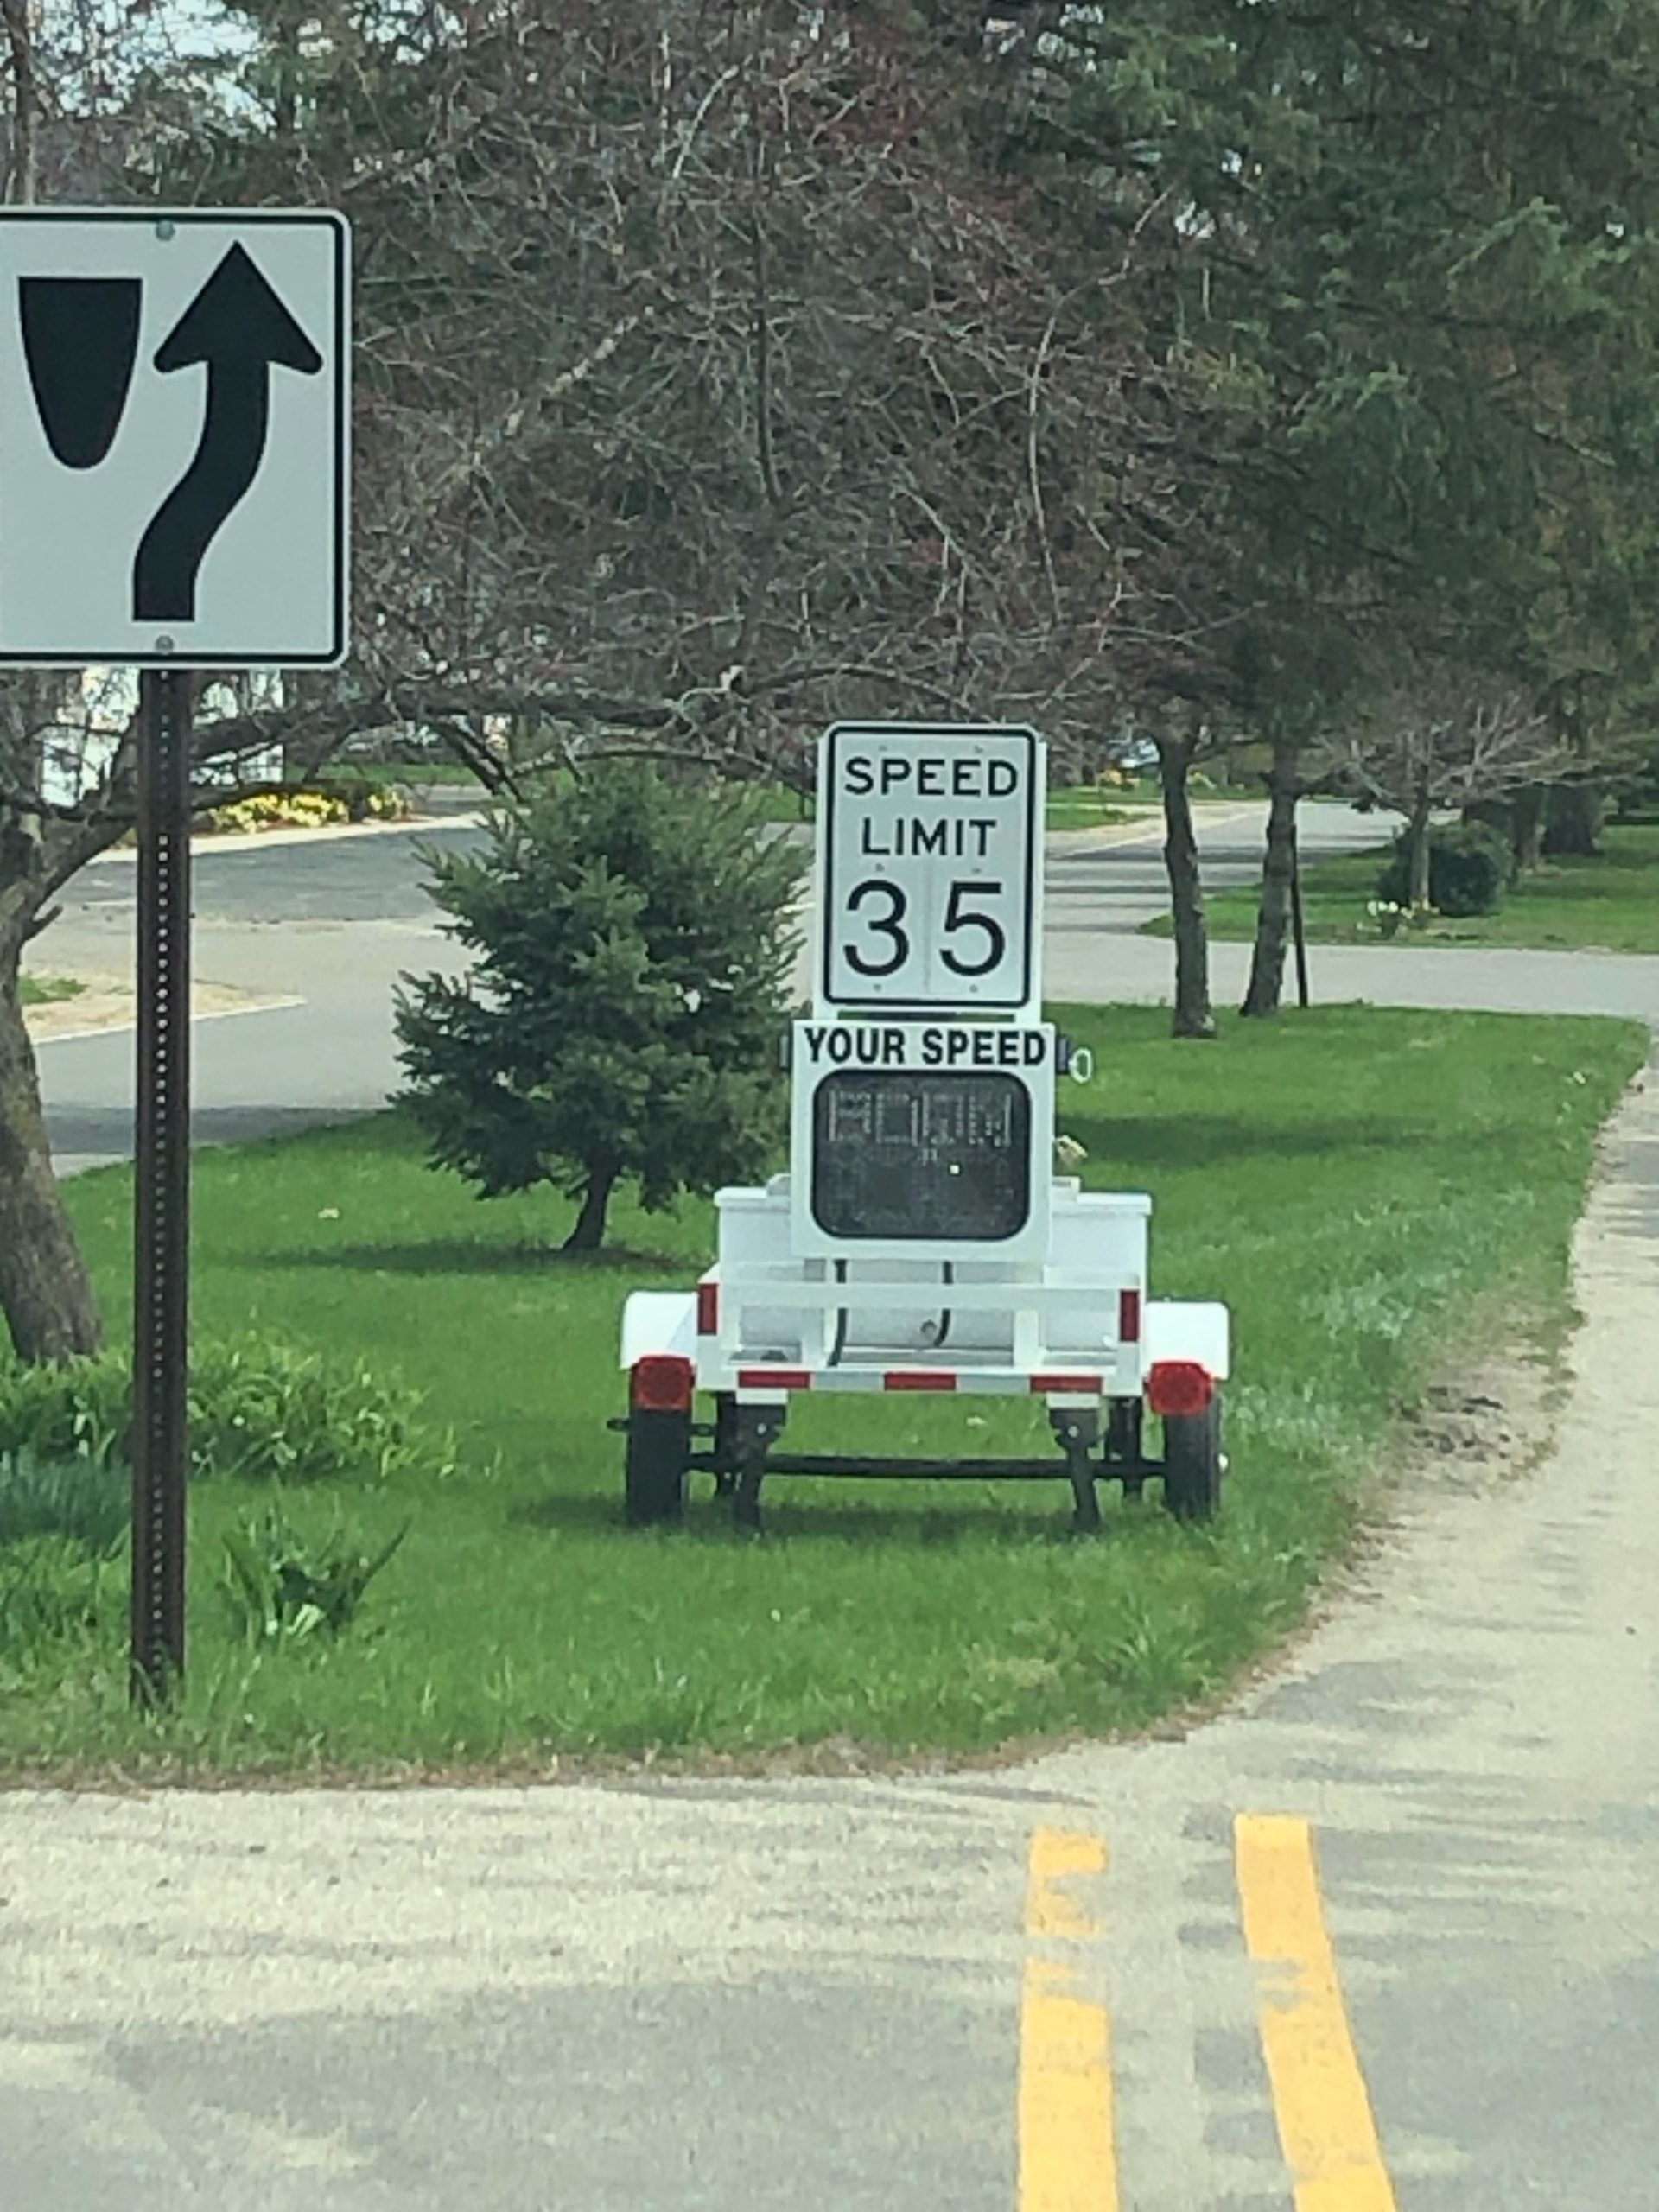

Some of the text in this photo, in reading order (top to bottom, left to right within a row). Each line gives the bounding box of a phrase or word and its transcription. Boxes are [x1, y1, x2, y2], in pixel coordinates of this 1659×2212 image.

[844, 757, 1018, 797] SPEED
[862, 817, 996, 856] LIMIT
[843, 880, 1006, 977] 35
[804, 1028, 1046, 1065] YOUR SPEED
